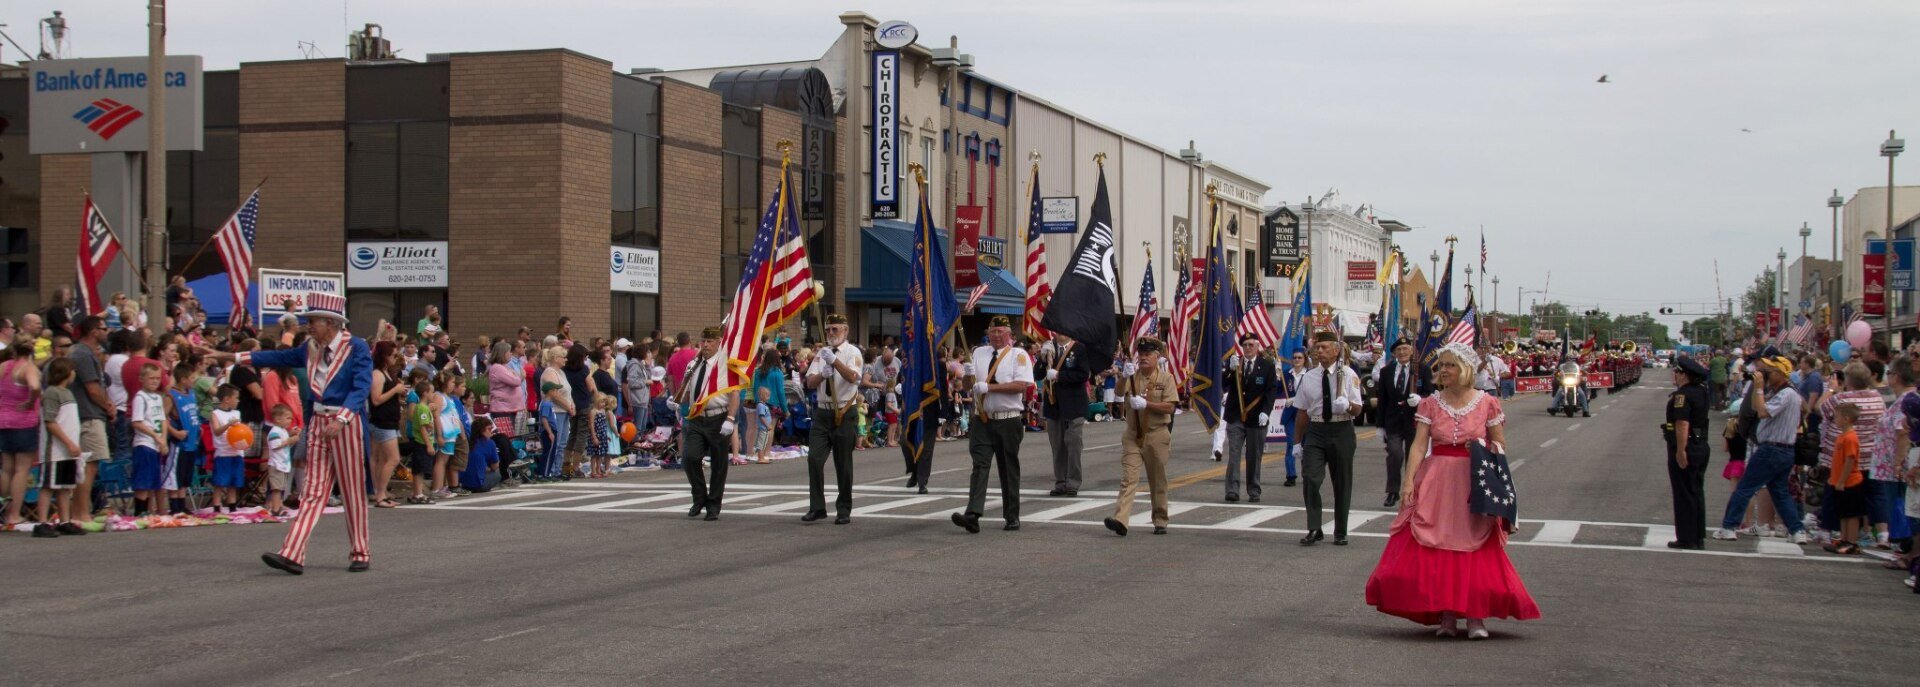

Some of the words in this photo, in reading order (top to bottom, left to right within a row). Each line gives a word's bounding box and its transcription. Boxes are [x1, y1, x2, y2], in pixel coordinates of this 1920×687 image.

[36, 70, 80, 92] Bank
[82, 69, 101, 89] of
[104, 68, 186, 88] Ameca
[880, 58, 891, 196] CHIROPRACTIC
[382, 247, 438, 258] Elliott
[627, 252, 654, 265] Elliott
[1073, 247, 1109, 288] POW
[269, 277, 335, 291] INFORMATION
[296, 295, 303, 306] &
